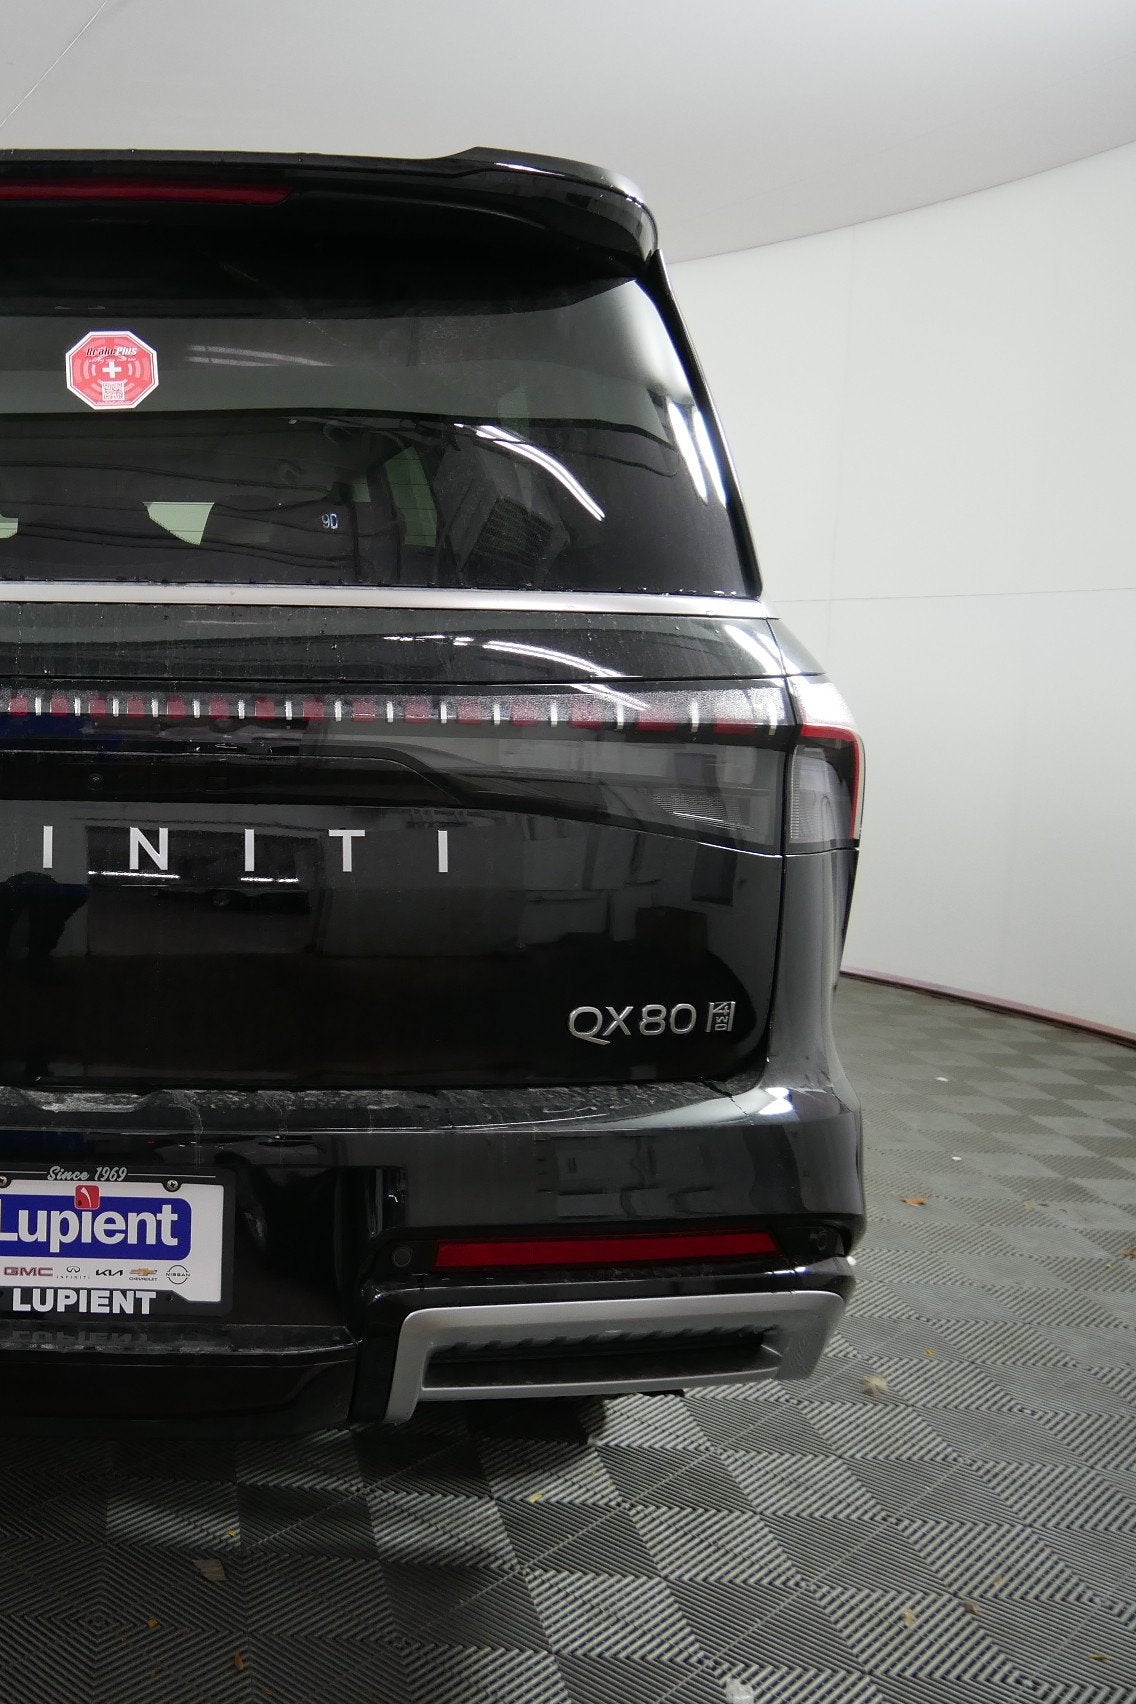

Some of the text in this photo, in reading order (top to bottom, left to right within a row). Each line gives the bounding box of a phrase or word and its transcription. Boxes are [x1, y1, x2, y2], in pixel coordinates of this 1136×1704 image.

[568, 1003, 697, 1045] QX80
[47, 1166, 127, 1182] Since 1969
[3, 1267, 53, 1277] GMC
[95, 1269, 124, 1277] KIA
[13, 1288, 157, 1315] LUPIENT
